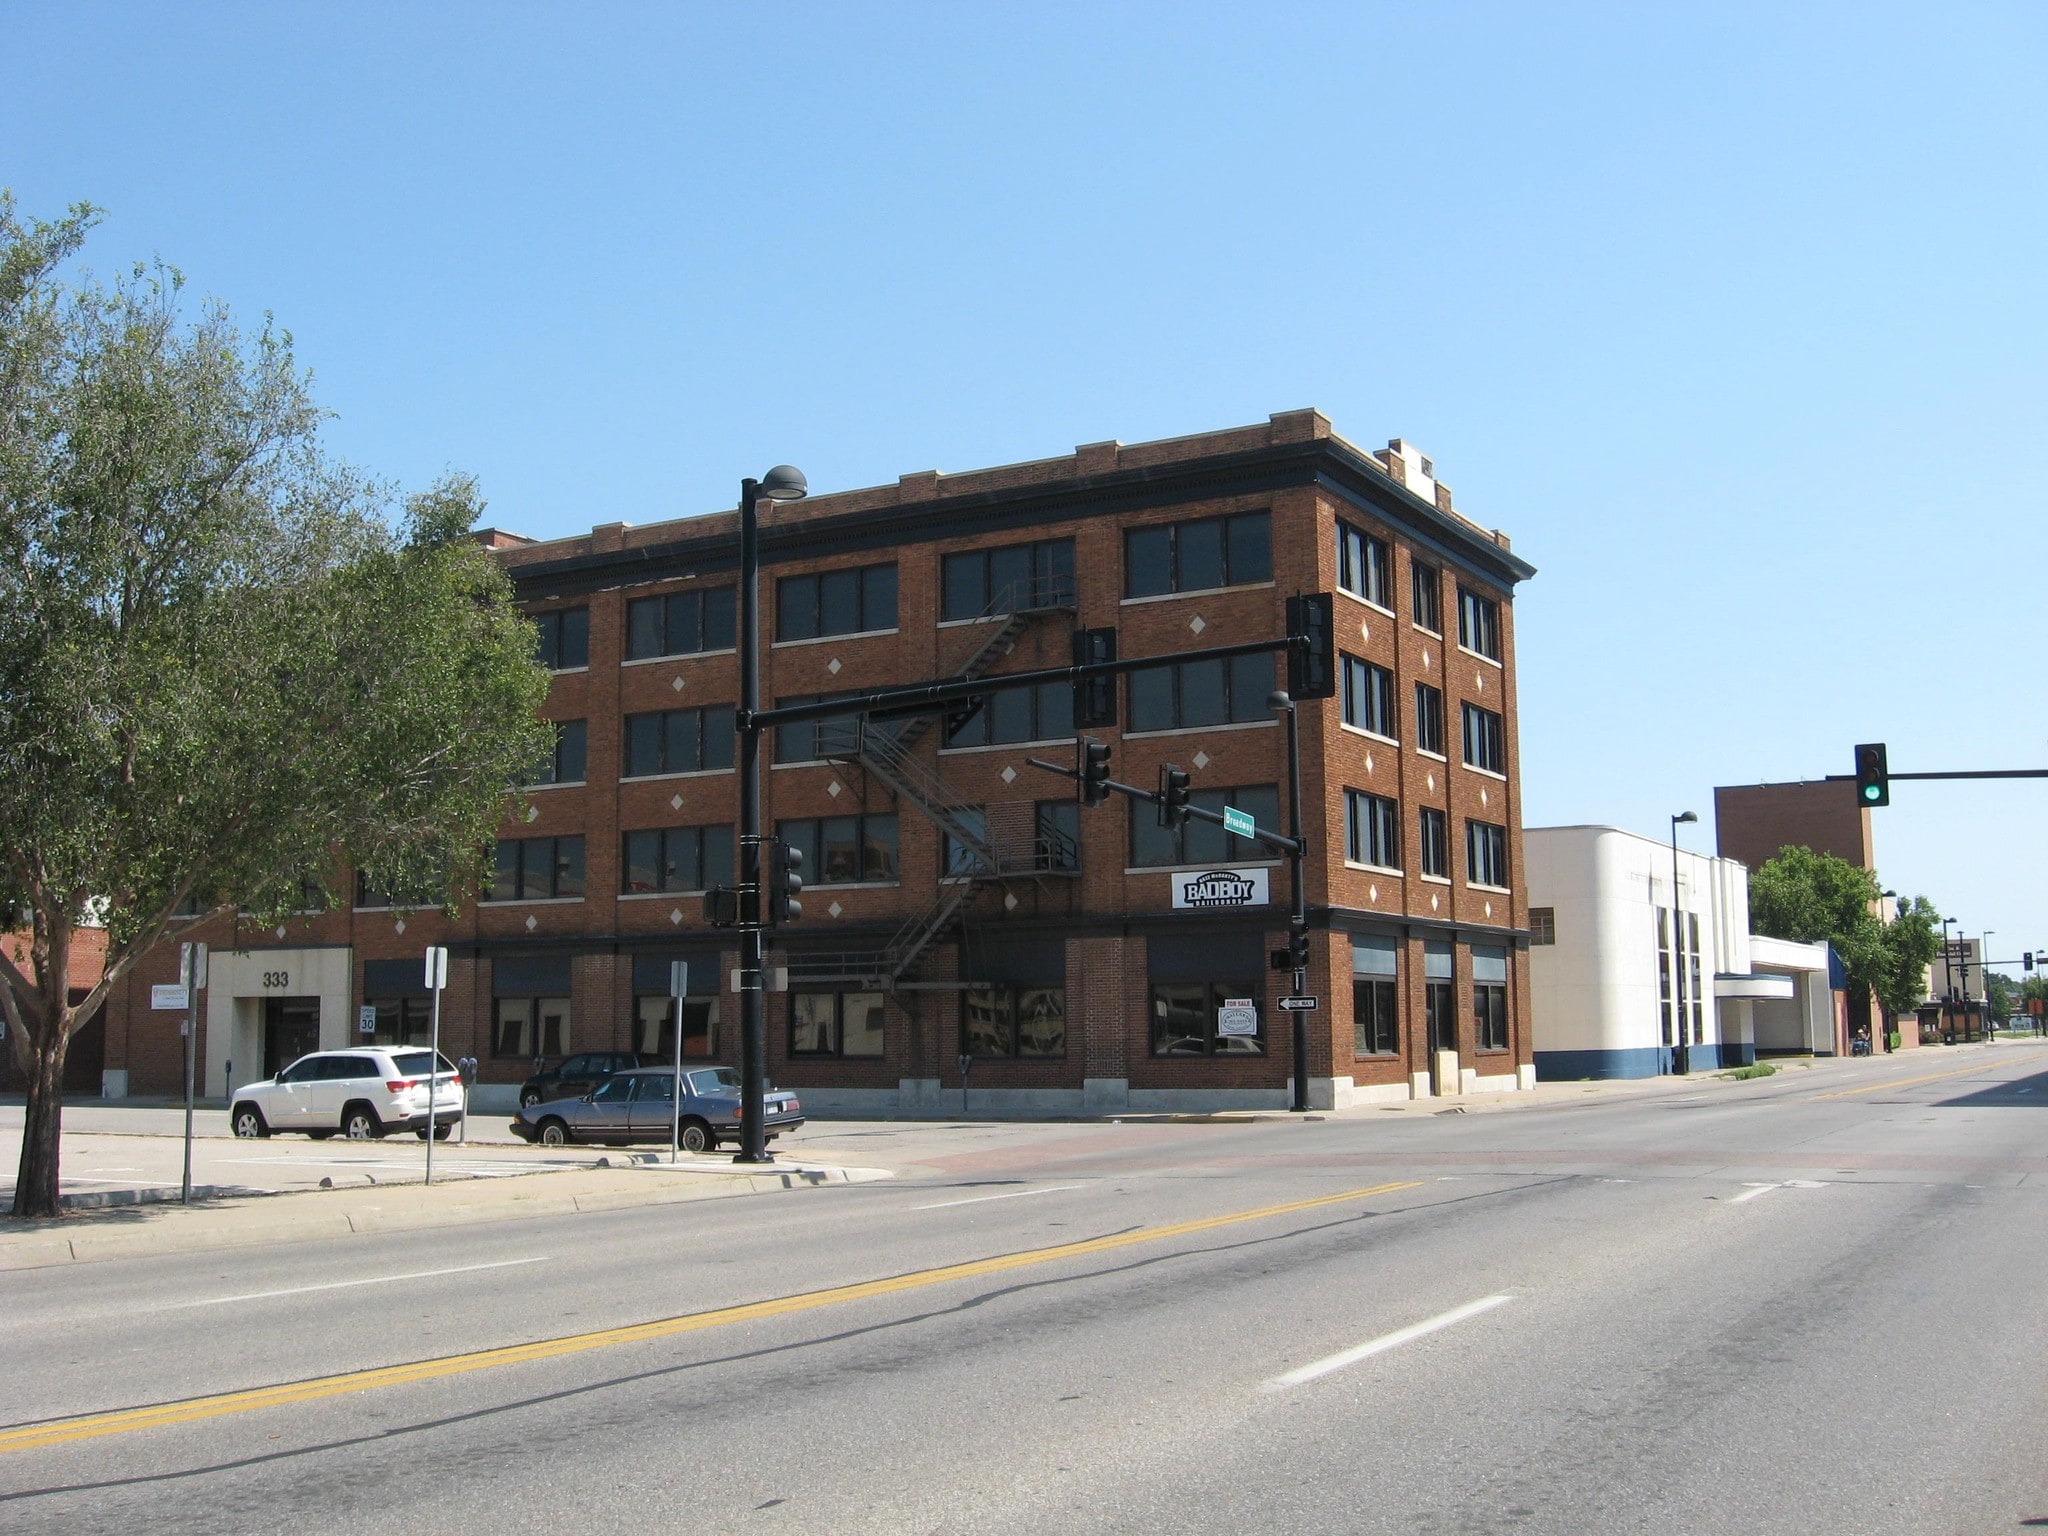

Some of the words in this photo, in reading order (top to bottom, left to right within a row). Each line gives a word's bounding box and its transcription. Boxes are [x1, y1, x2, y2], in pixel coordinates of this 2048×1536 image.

[1226, 812, 1253, 836] Broadway
[263, 971, 289, 988] 333
[361, 1019, 374, 1030] 30
